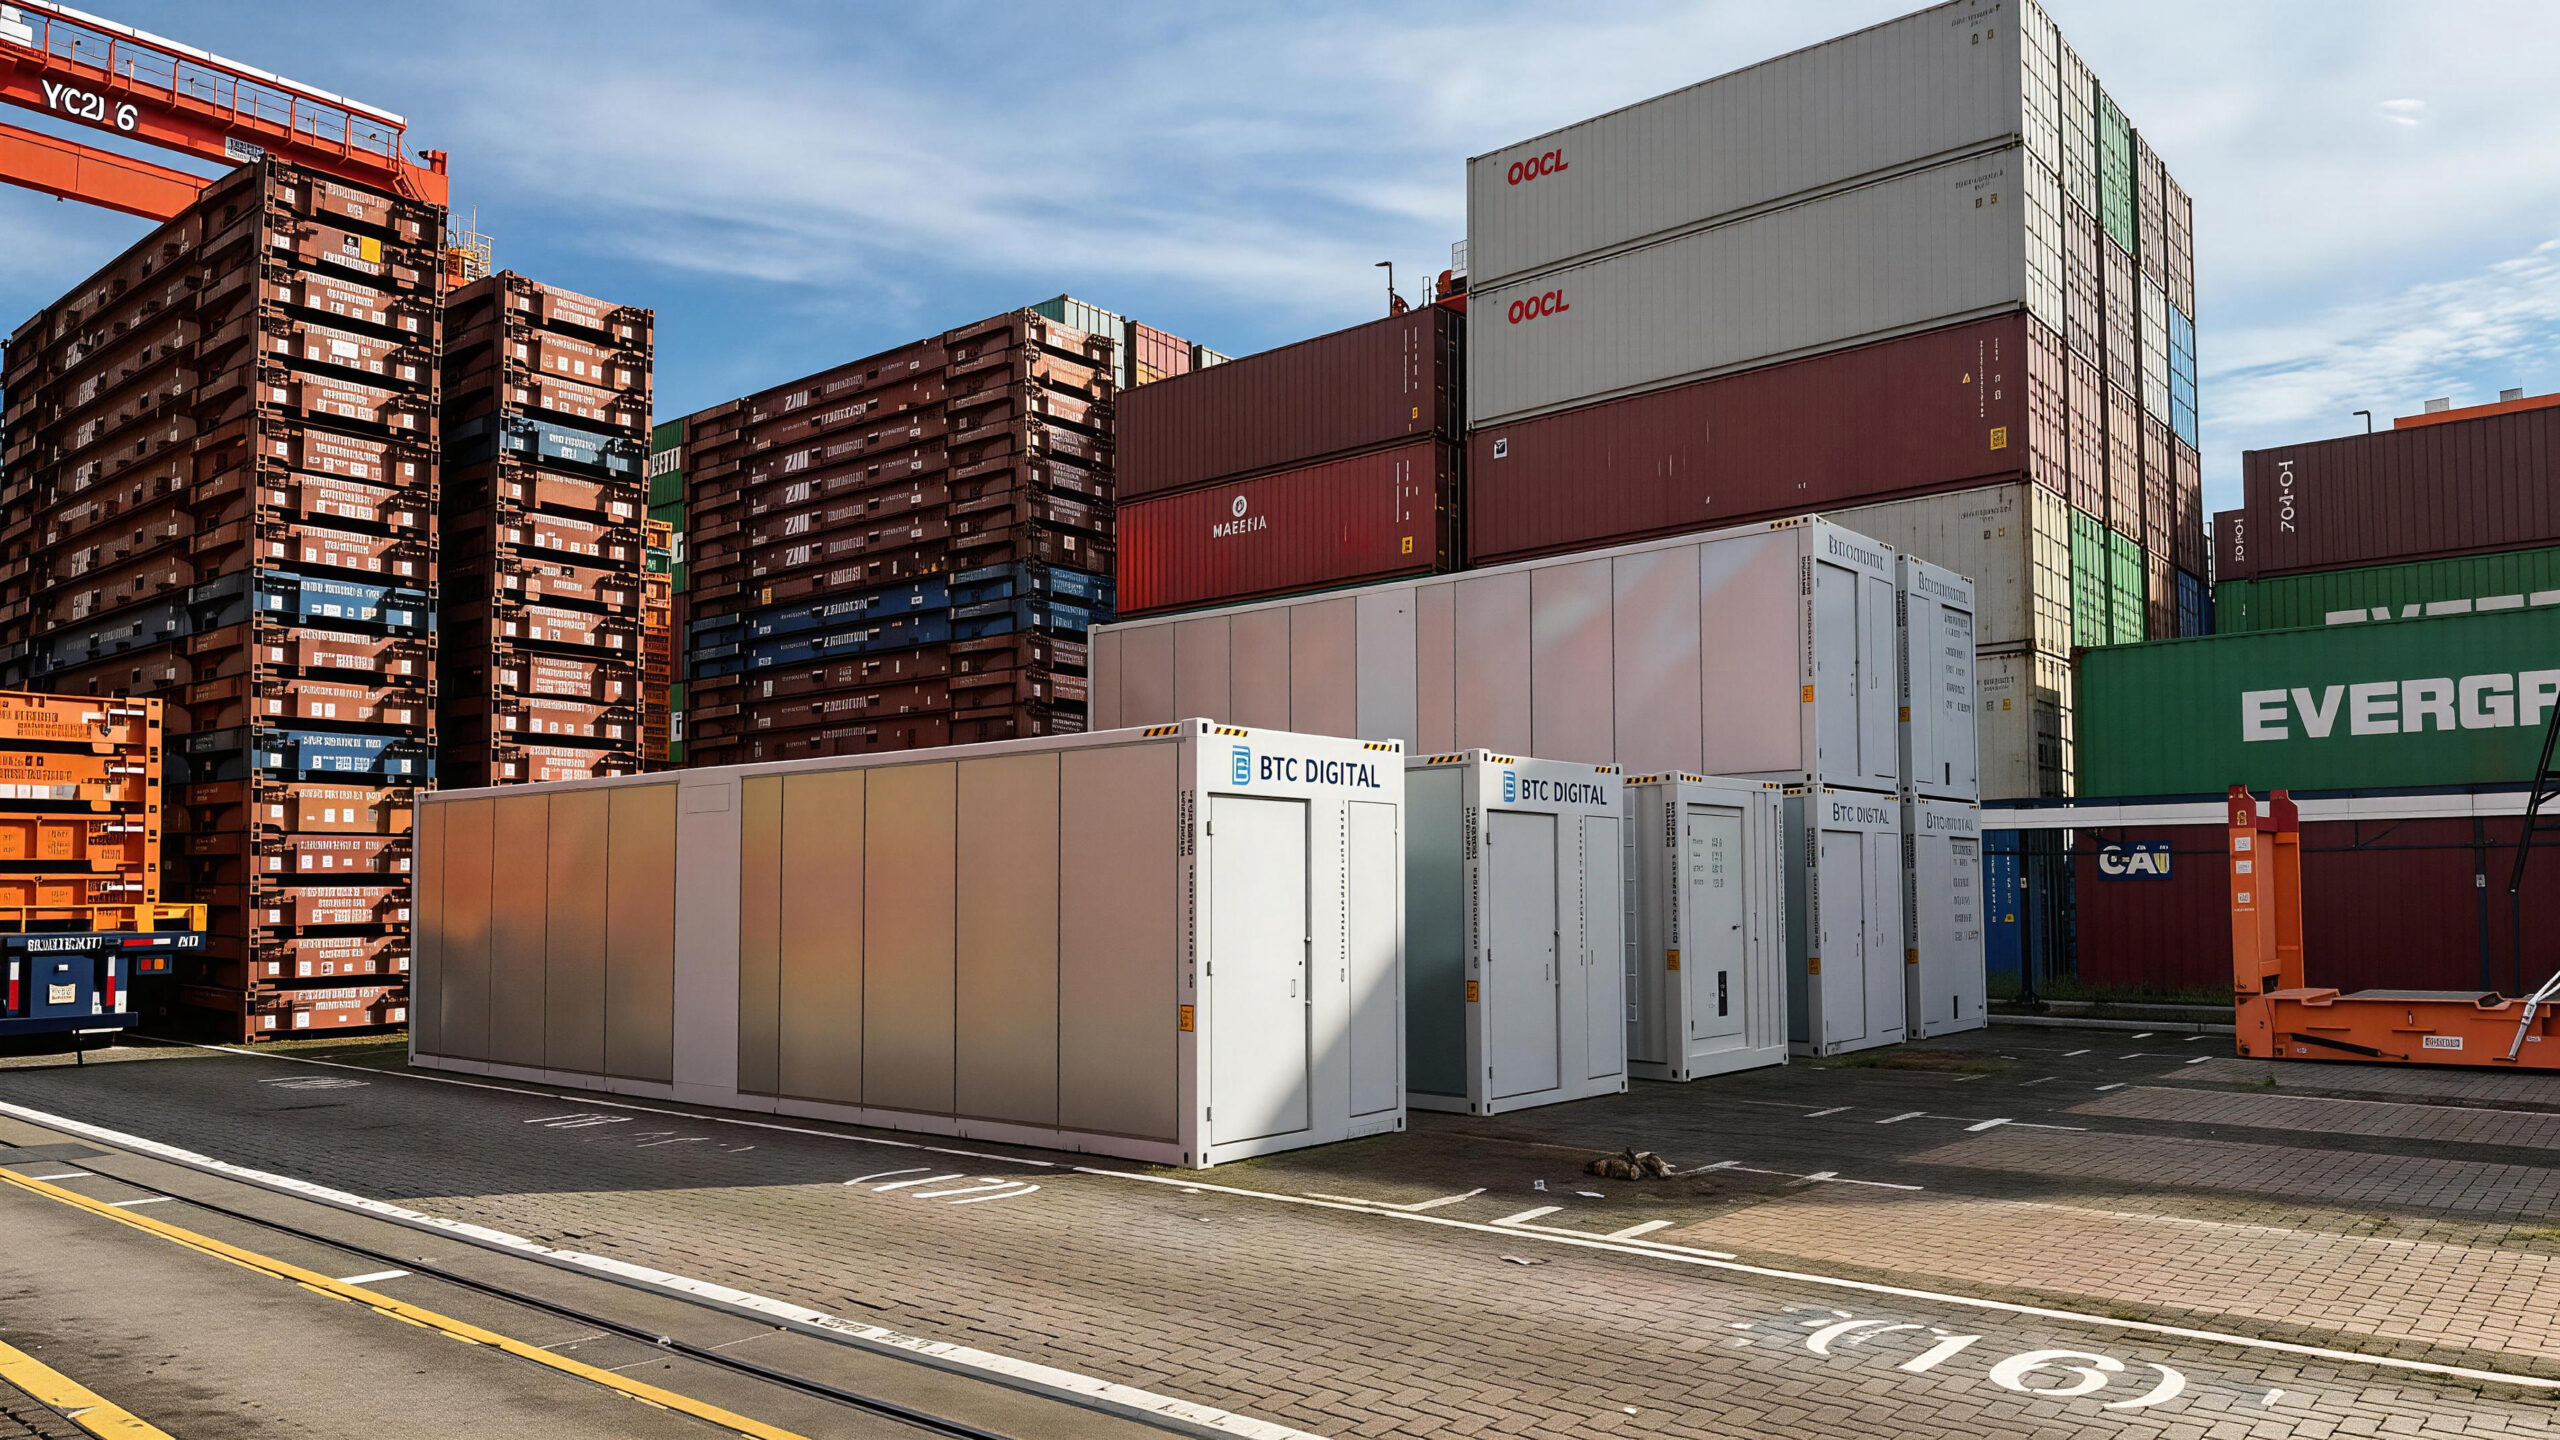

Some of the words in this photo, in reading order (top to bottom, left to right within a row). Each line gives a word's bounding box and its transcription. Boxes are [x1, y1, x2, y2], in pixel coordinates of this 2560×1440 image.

[1507, 148, 1569, 186] OOCL
[1507, 289, 1570, 325] OOCL
[1260, 755, 1298, 782] BTC
[1305, 758, 1381, 788] DIGITAL
[1521, 779, 1549, 801] BTC
[1554, 781, 1608, 806] DIGITAL
